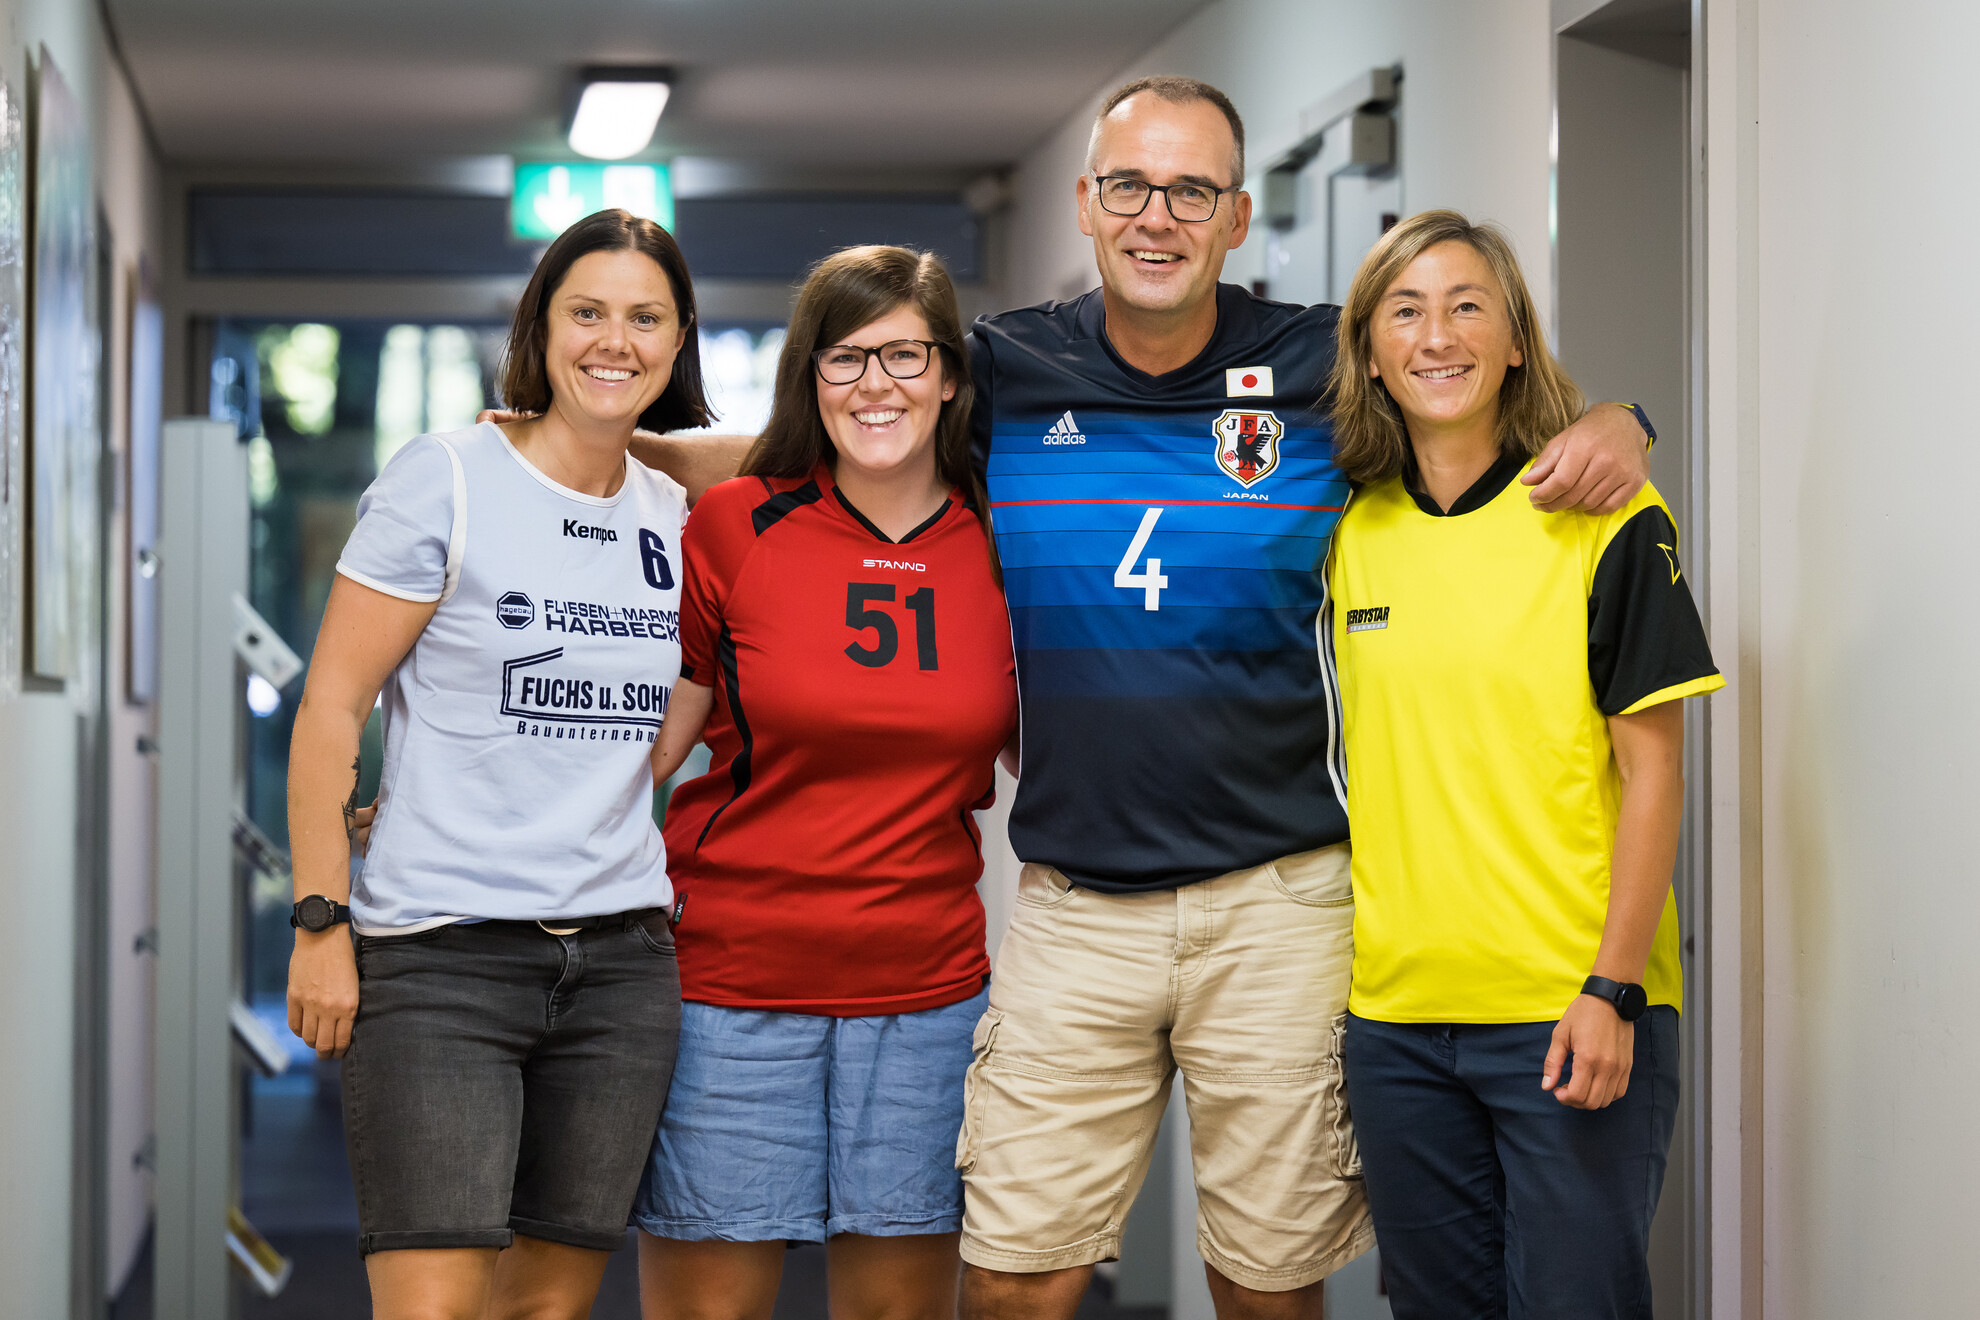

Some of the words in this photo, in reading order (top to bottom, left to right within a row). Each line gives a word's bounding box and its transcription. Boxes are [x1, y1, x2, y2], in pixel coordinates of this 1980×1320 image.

[1042, 432, 1087, 445] adidas
[1222, 492, 1269, 501] JAPAN
[563, 518, 618, 546] Kempa
[639, 527, 675, 591] 6
[862, 558, 926, 572] STANNO
[1114, 507, 1168, 611] 4
[499, 606, 532, 615] hagebau
[545, 613, 681, 645] HARBECK
[844, 582, 939, 671] 51
[521, 676, 593, 710] FUCHS
[599, 687, 617, 710] u.
[517, 720, 660, 743] Bauunternehm
